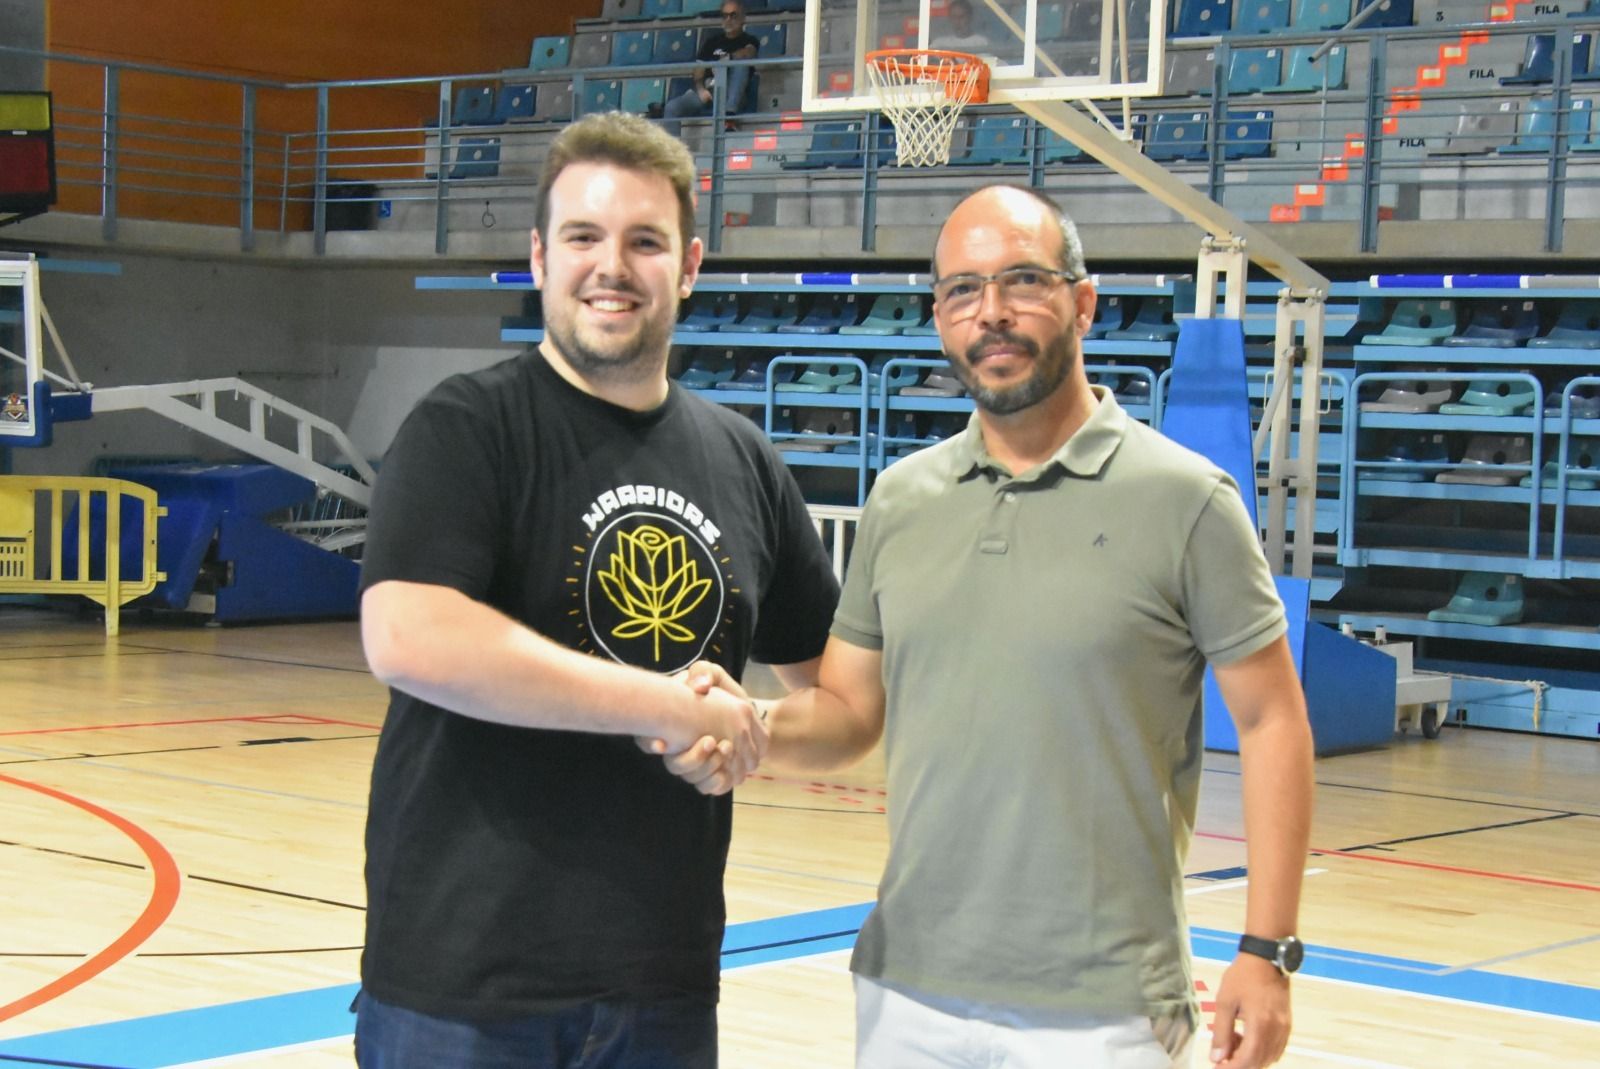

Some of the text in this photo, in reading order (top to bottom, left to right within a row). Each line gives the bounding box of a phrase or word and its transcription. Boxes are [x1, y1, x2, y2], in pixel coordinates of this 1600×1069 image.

[1534, 5, 1560, 15] FILA
[1469, 68, 1495, 79] FILA
[1399, 137, 1426, 148] FILA
[767, 153, 788, 163] FILA
[582, 484, 721, 545] WARRIORS
